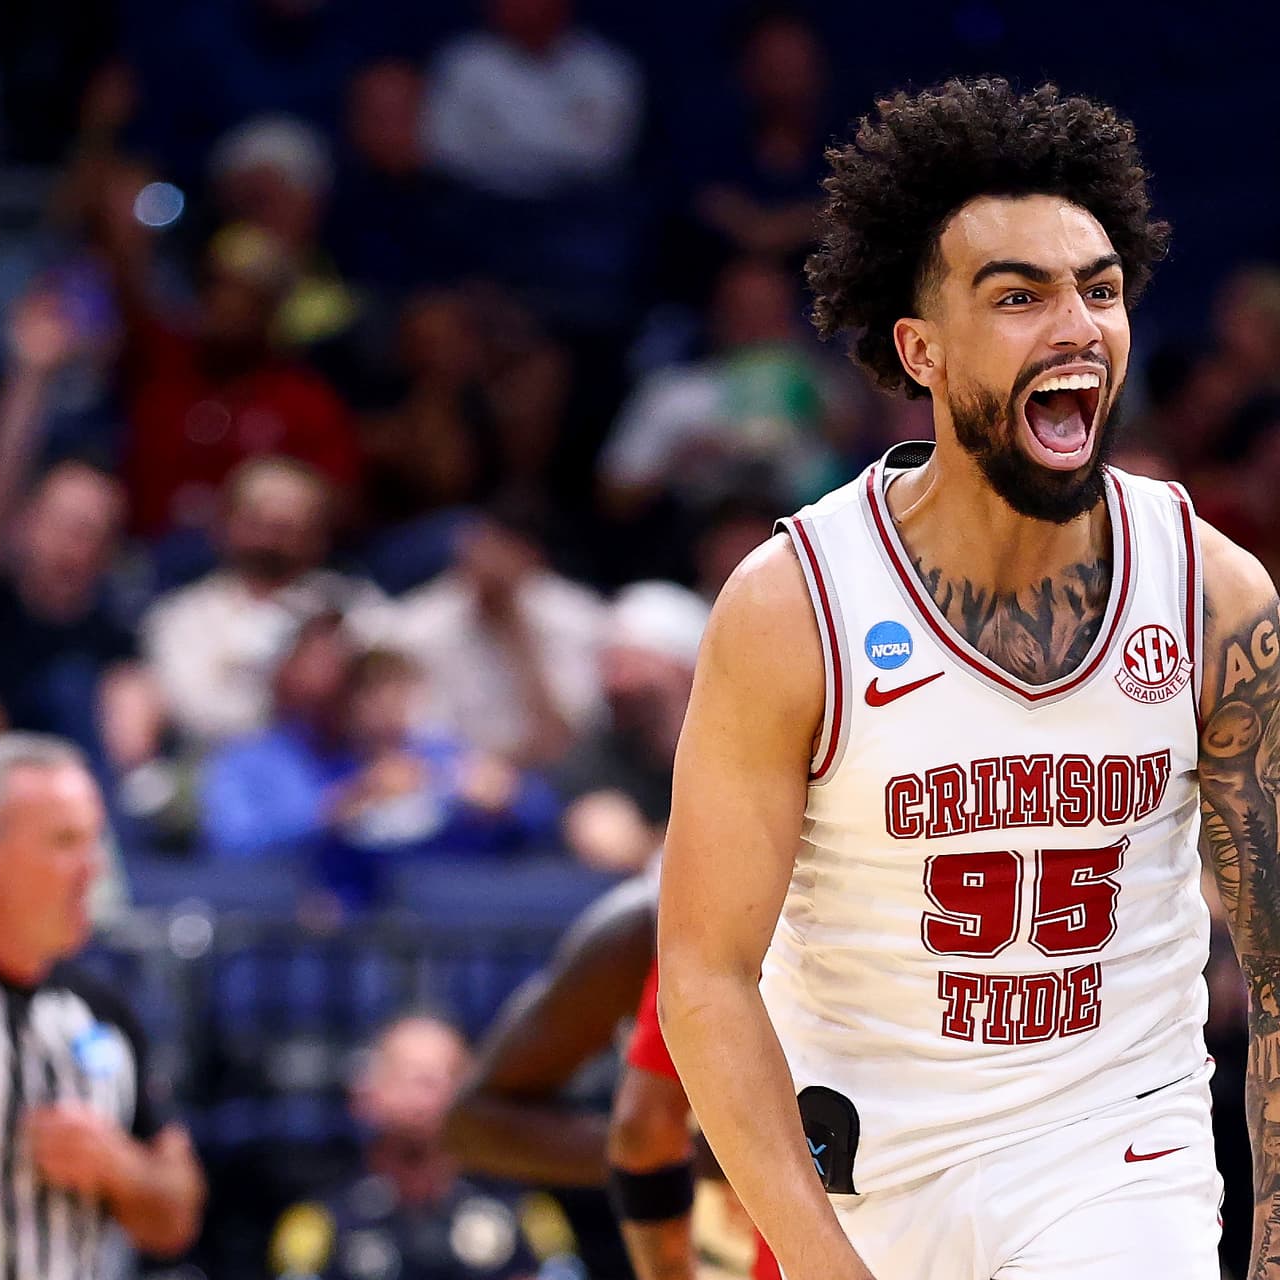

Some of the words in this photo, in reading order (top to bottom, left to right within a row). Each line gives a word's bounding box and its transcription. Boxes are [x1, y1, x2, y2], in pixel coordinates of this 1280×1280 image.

[871, 642, 910, 658] NCAA
[1126, 628, 1176, 682] SEC
[1125, 674, 1186, 702] GRADUATE
[885, 748, 1171, 840] CRIMSON
[920, 834, 1131, 959] 95
[937, 962, 1103, 1046] TIDE
